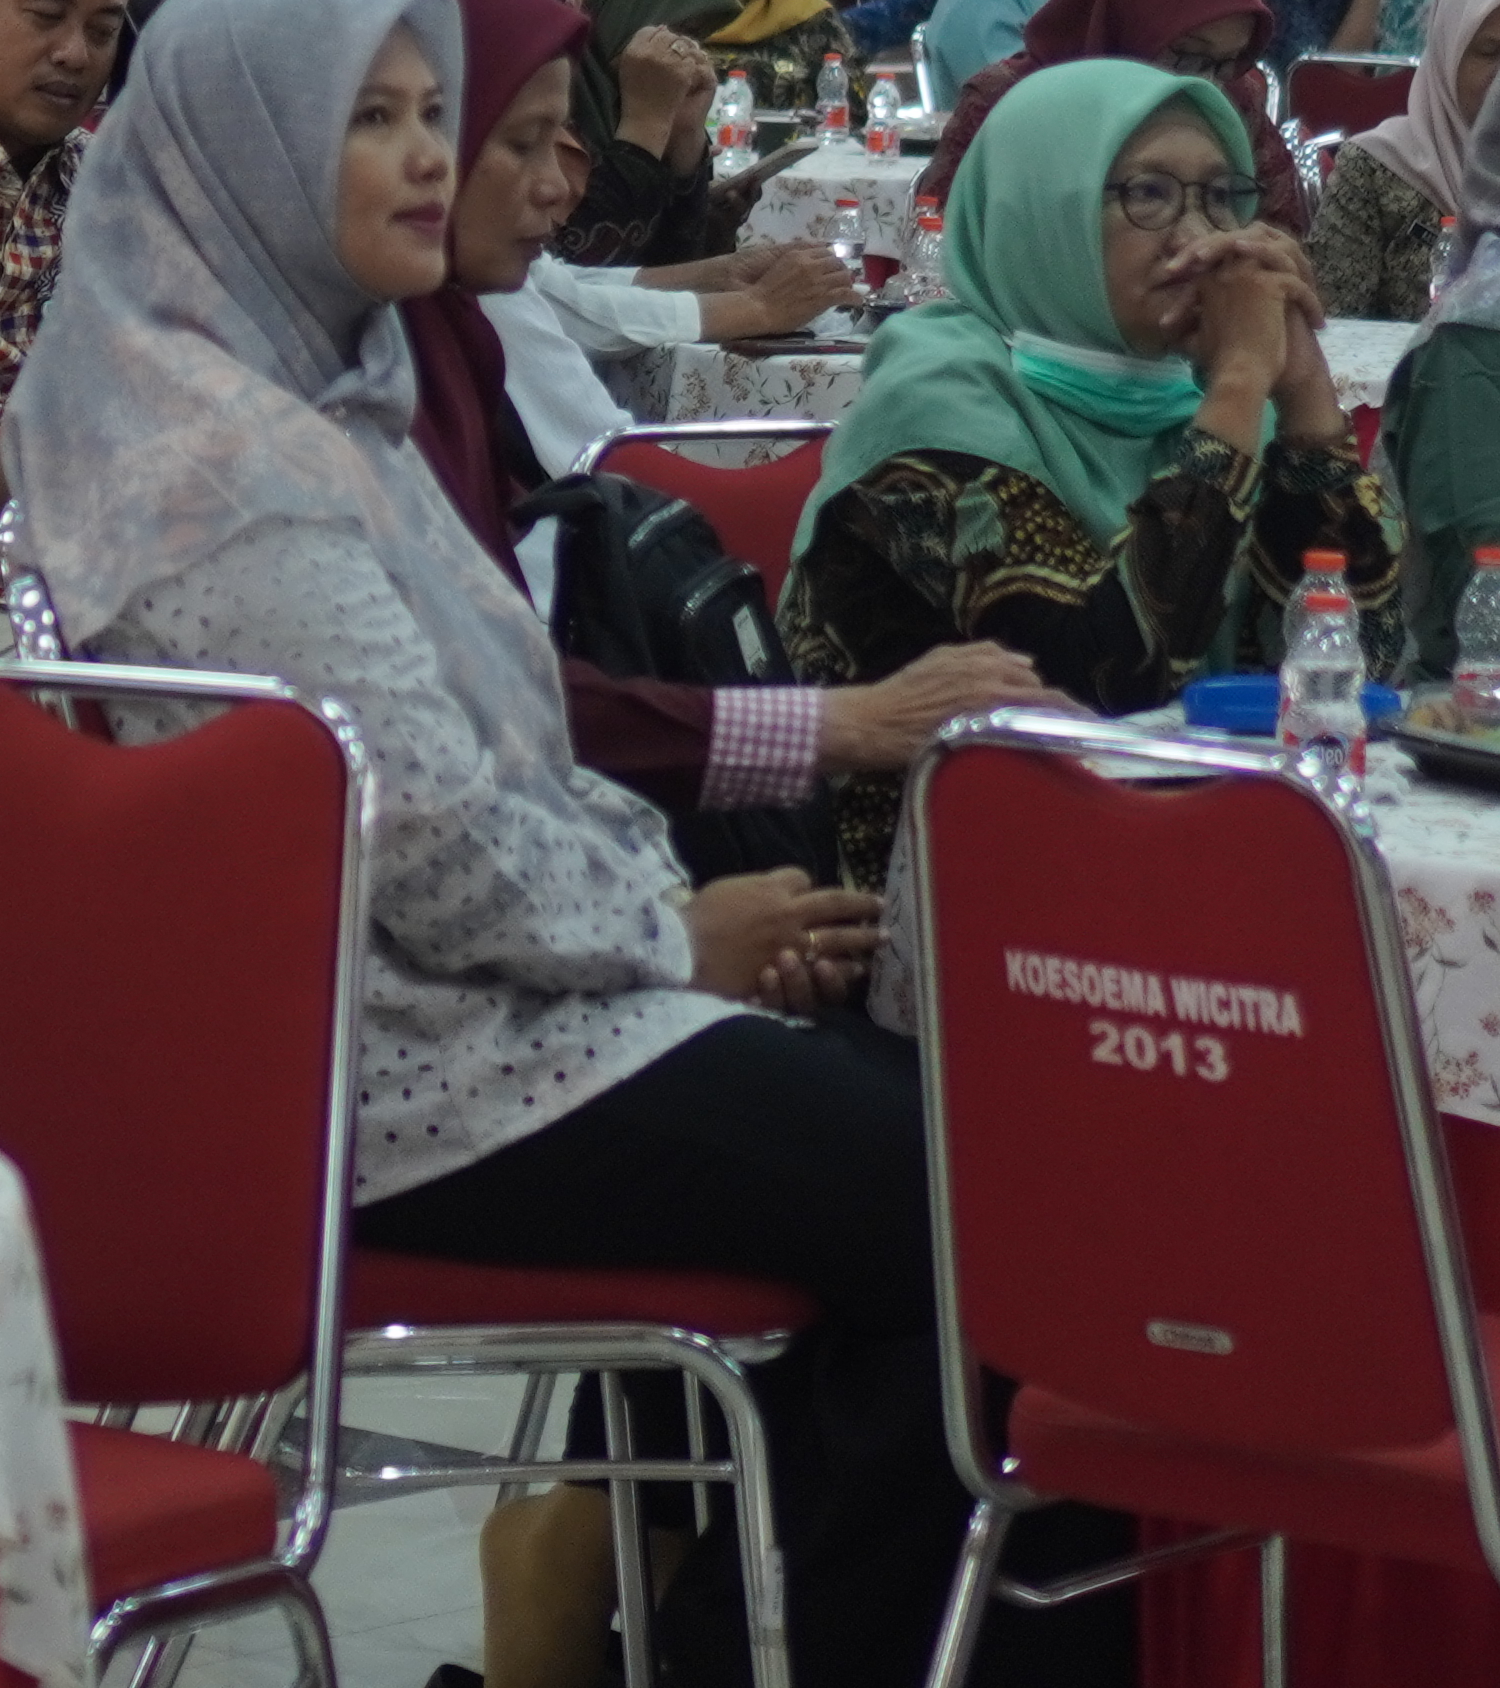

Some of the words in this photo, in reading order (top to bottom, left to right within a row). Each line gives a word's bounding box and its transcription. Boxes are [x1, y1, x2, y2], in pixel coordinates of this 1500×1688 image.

[1004, 948, 1167, 1018] KOESOEMA
[1170, 976, 1304, 1038] WICITRA
[1088, 1019, 1230, 1083] 2013
